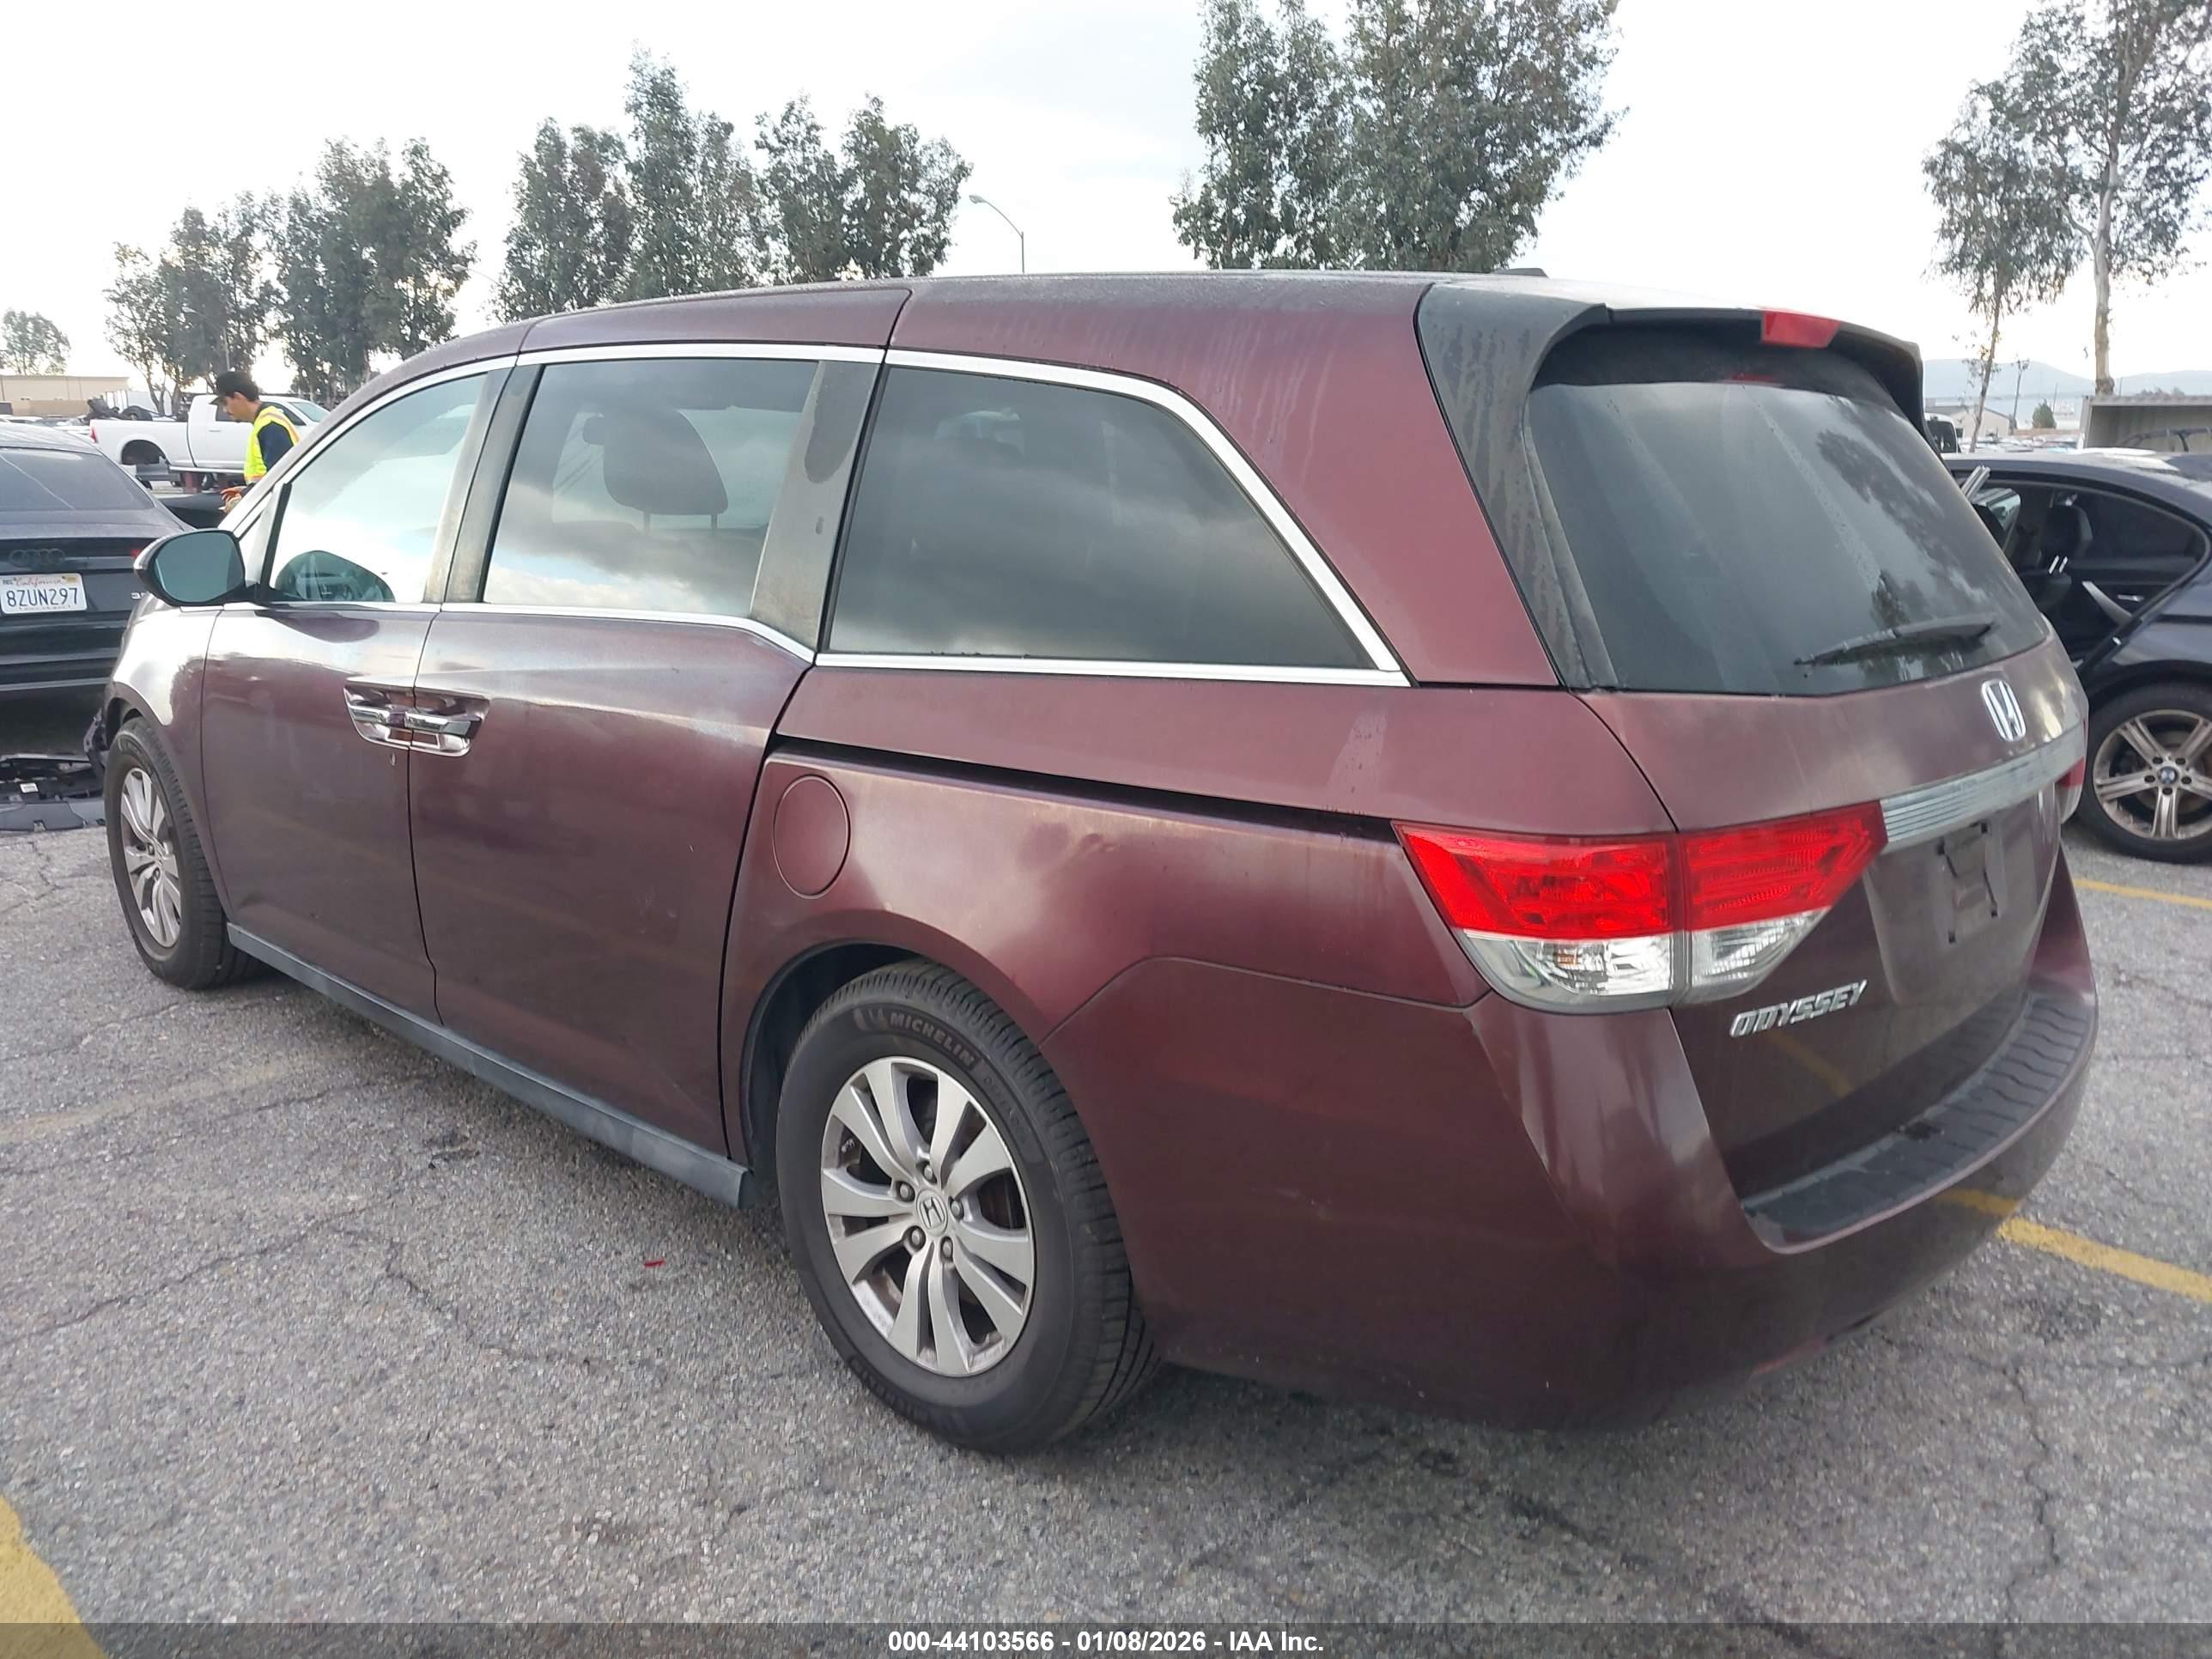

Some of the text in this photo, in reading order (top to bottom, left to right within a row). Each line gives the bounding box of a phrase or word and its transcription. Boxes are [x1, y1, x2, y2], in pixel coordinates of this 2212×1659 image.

[6, 587, 78, 607] 8ZUN297
[1729, 978, 1869, 1038] ODYSSEY
[890, 1012, 976, 1067] MICHELIN
